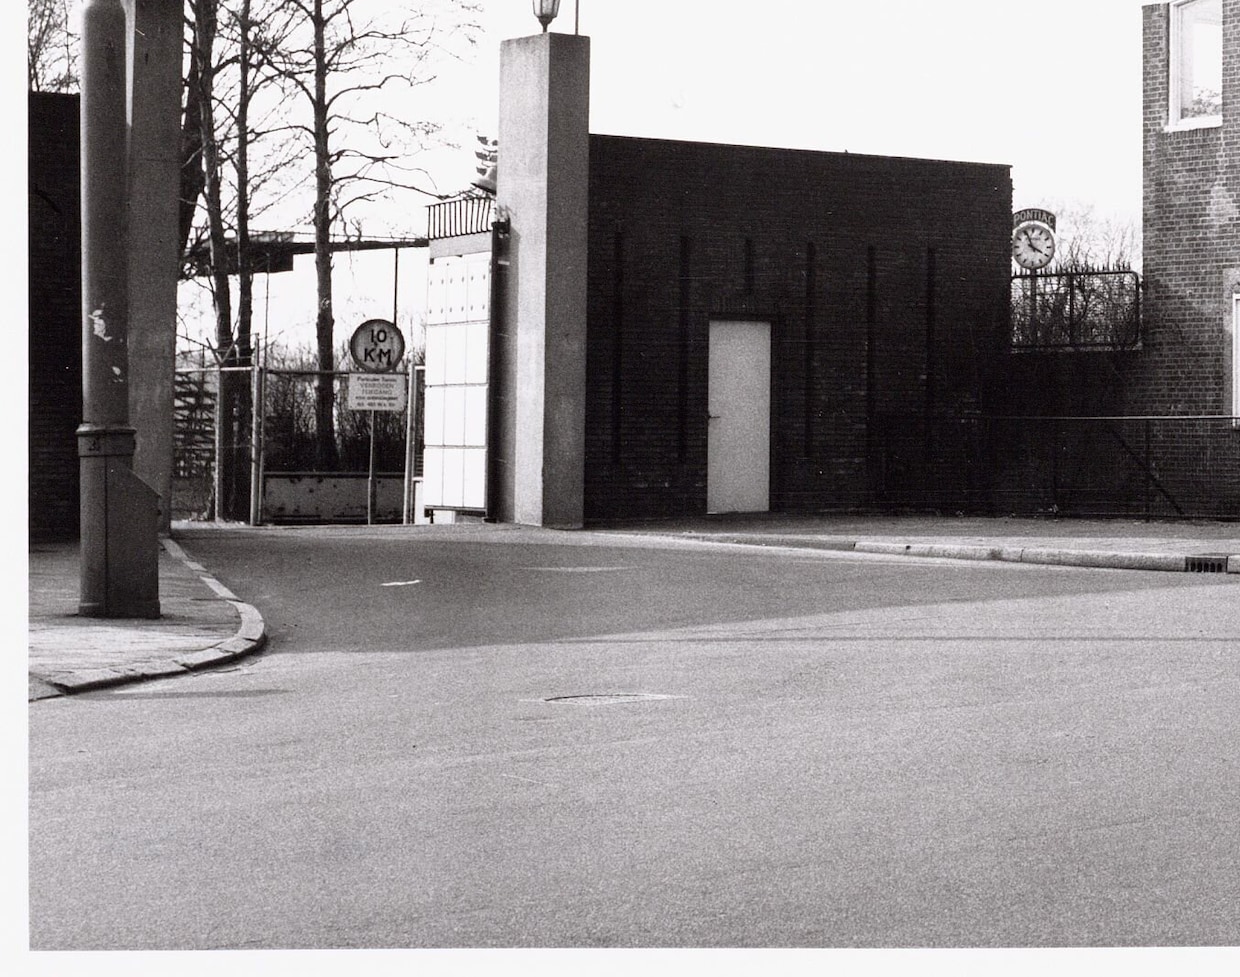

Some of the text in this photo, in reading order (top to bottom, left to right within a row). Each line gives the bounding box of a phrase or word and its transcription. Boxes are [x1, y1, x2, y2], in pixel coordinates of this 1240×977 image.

[1013, 209, 1054, 226] PONTIAC
[371, 329, 387, 343] 10
[364, 348, 391, 365] KM
